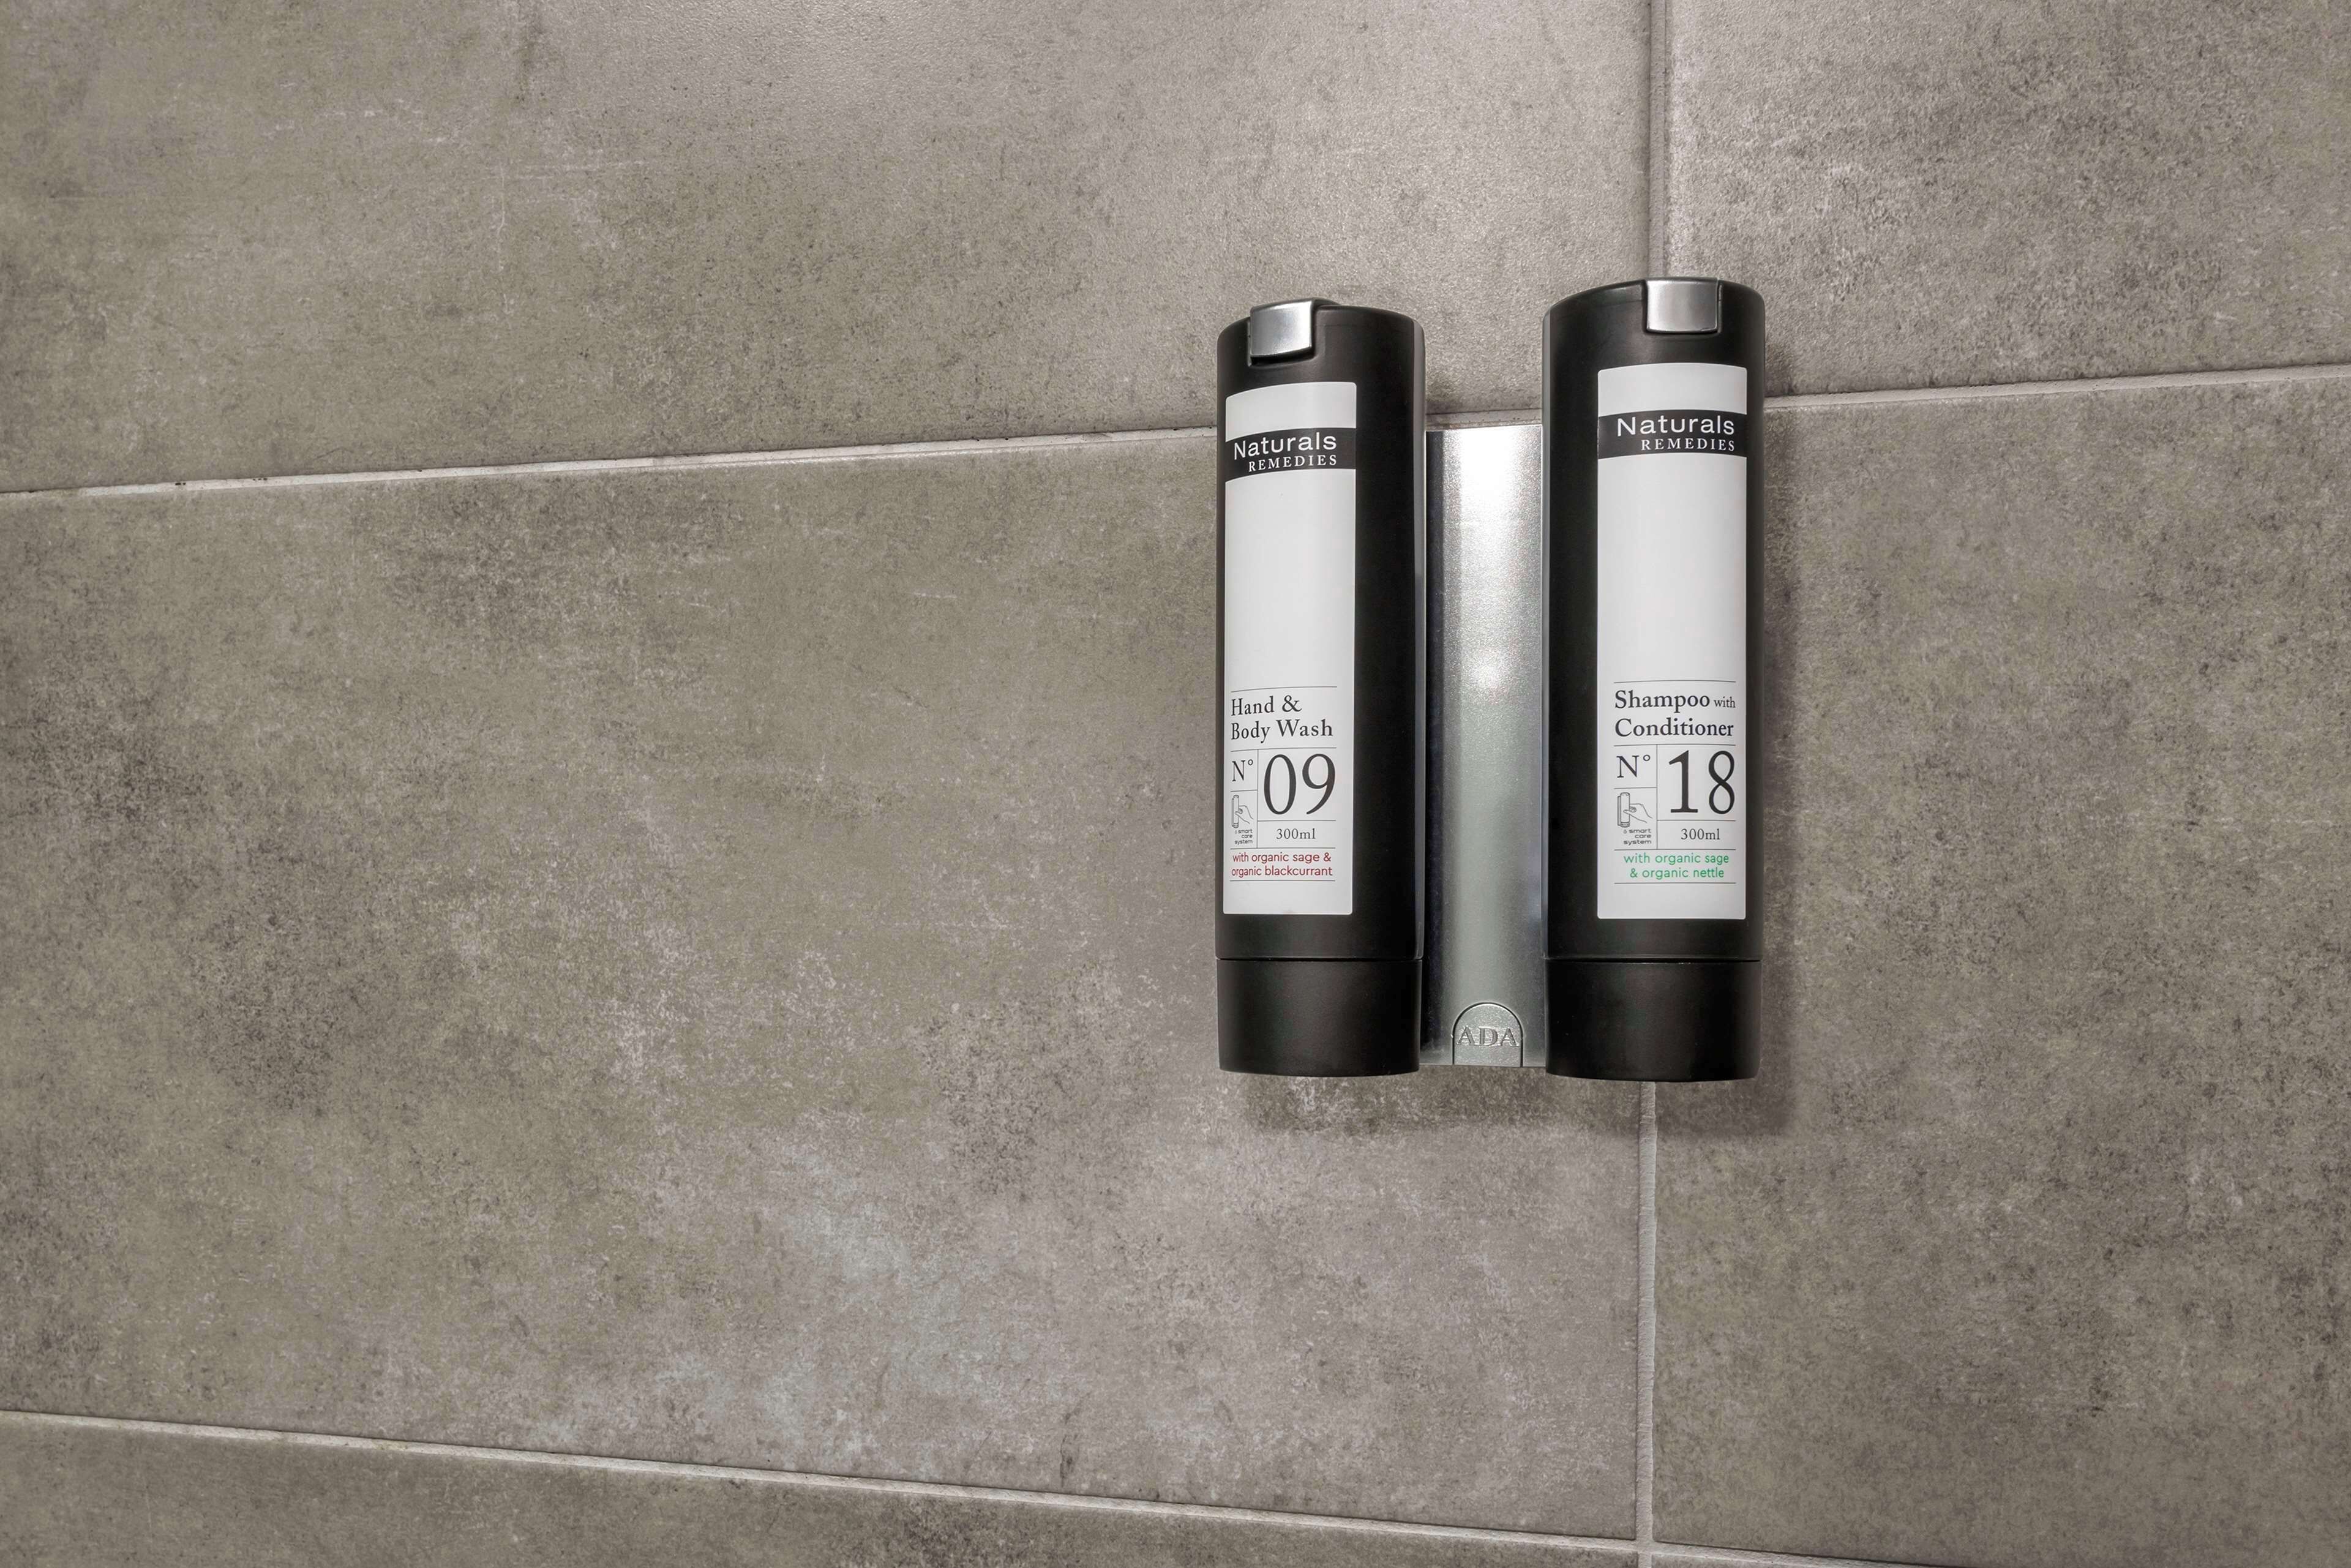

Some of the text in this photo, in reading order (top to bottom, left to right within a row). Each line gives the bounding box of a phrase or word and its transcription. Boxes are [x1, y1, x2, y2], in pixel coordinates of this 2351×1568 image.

[1618, 415, 1734, 437] Naturals
[1234, 432, 1337, 460] Naturals
[1641, 438, 1735, 451] REMEDIES
[1248, 454, 1337, 473] REMEDIES
[1231, 695, 1302, 716] Hand &
[1614, 689, 1736, 713] Shampoo with
[1231, 718, 1333, 744] Body Wash
[1614, 717, 1734, 737] Conditioner
[1264, 753, 1336, 815] 09
[1668, 750, 1735, 814] 18
[1276, 828, 1316, 839] 300ml
[1680, 828, 1721, 840] 300ml
[1232, 852, 1332, 864] with organic sage &
[1623, 852, 1730, 866] with organic sage
[1231, 865, 1333, 878] organic blackcurrant
[1630, 867, 1725, 880] & organic nettle
[1457, 1026, 1520, 1047] ADA
